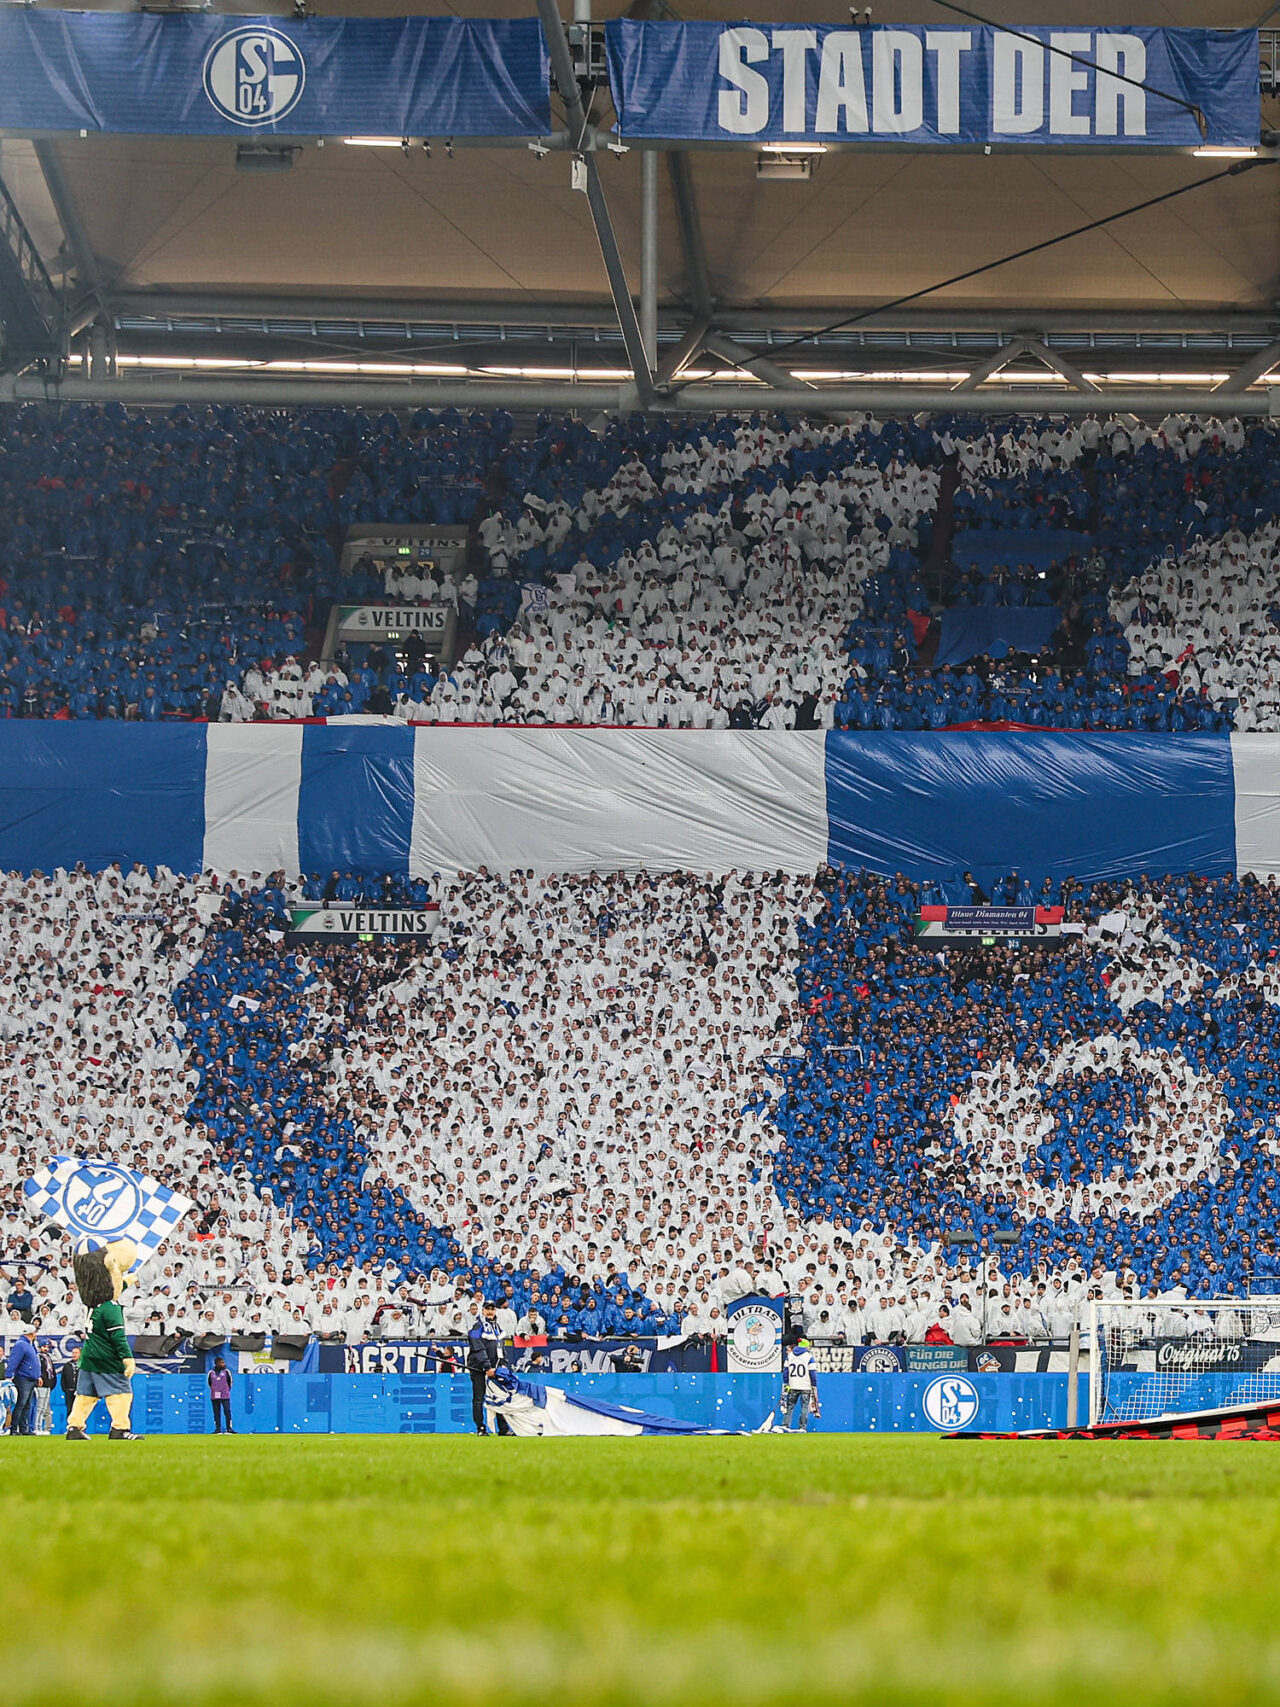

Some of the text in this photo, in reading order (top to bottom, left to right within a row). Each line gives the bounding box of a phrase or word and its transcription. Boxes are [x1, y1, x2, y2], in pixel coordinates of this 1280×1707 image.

[719, 27, 1146, 137] STADT DER
[371, 610, 445, 628] VELTINS
[951, 910, 974, 918] Blaue
[975, 910, 1017, 918] Diamanten
[340, 912, 427, 933] VELTINS
[383, 936, 396, 945] N2
[1008, 940, 1020, 949] N3
[732, 1304, 779, 1322] ULTRAS
[813, 1347, 853, 1361] BLUE
[910, 1349, 932, 1359] FÜR
[934, 1350, 954, 1359] DIE
[1158, 1342, 1226, 1371] Original
[1226, 1344, 1240, 1361] 75
[788, 1363, 806, 1378] 20
[909, 1359, 968, 1369] JUNGS DIE
